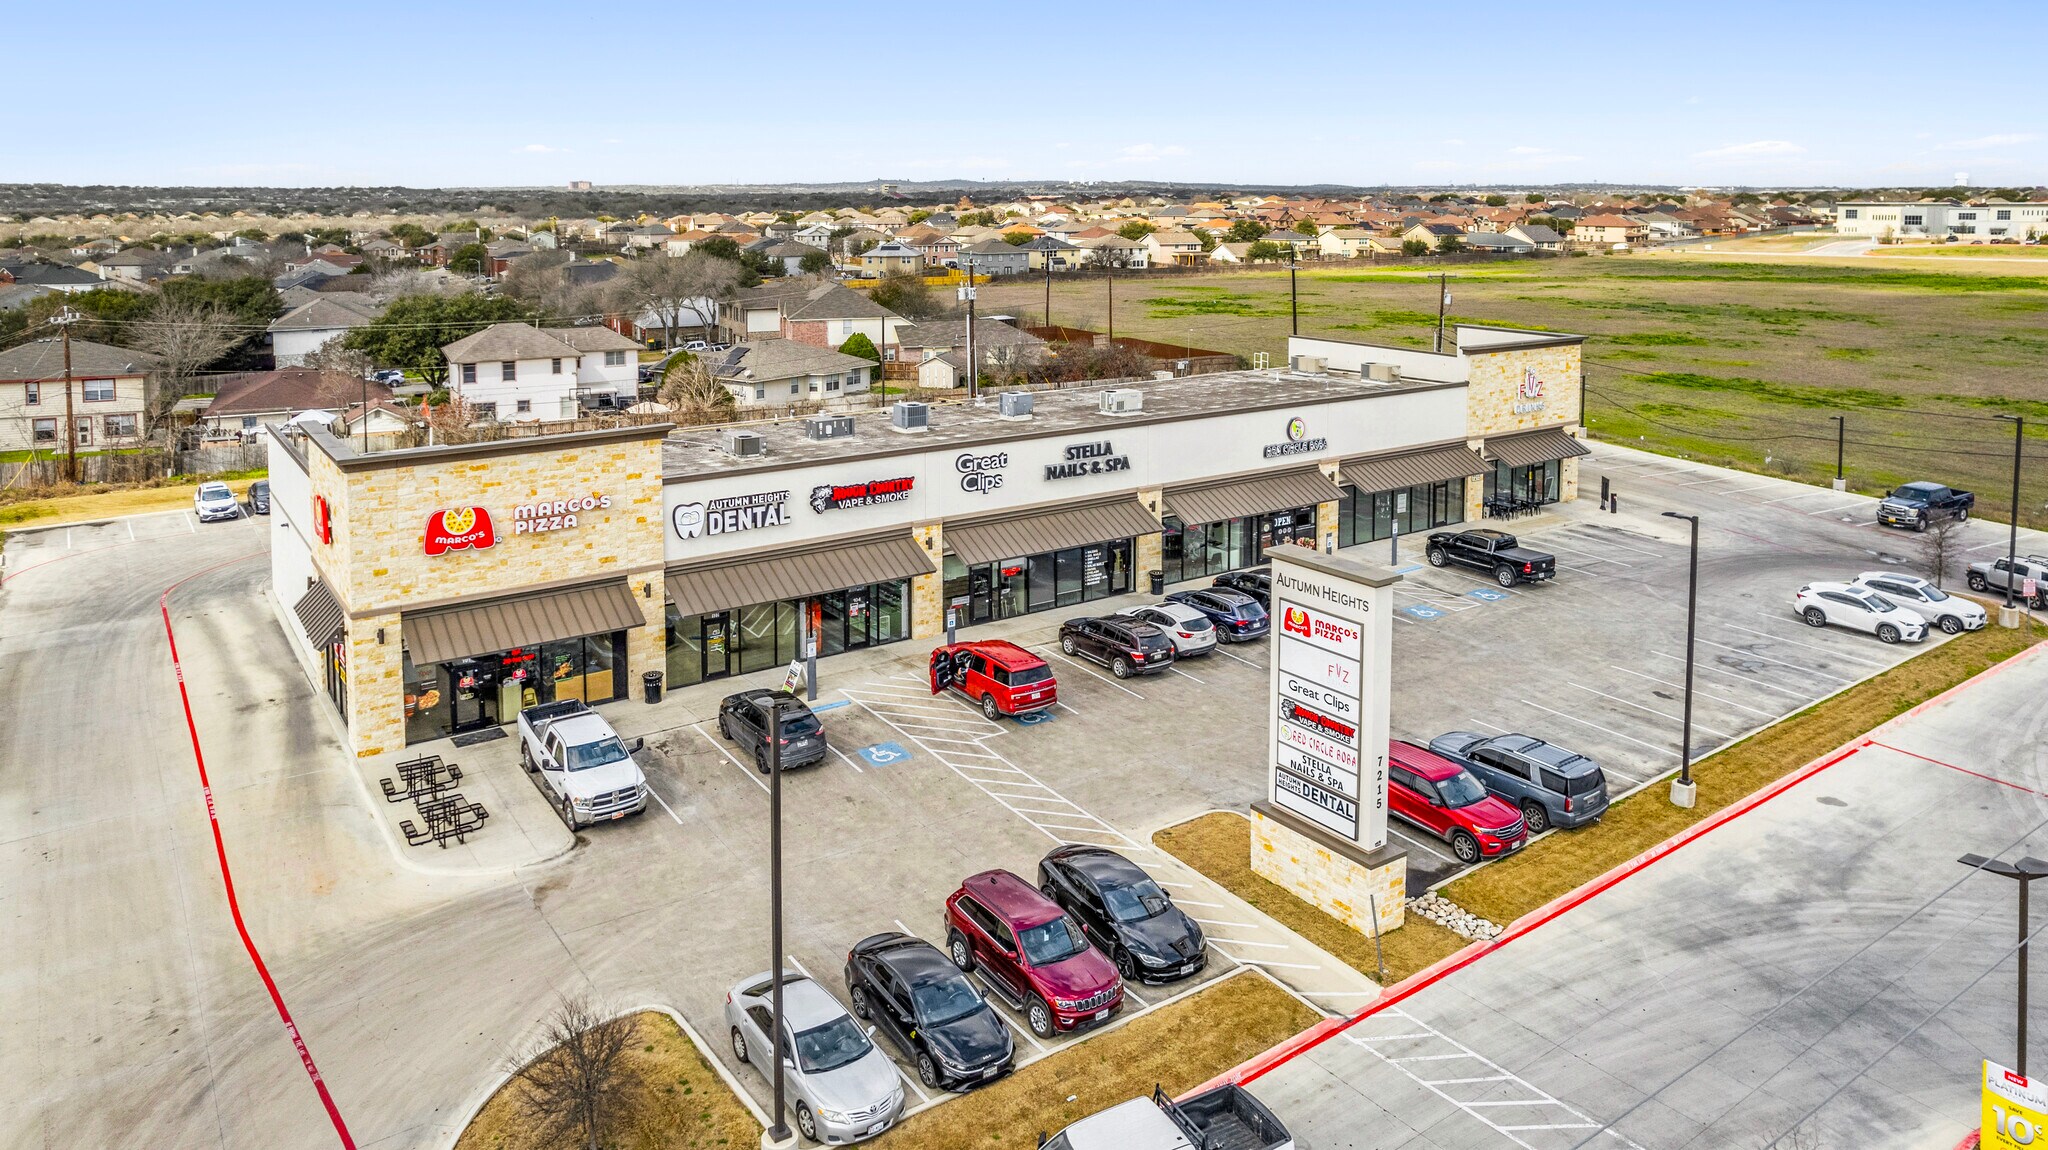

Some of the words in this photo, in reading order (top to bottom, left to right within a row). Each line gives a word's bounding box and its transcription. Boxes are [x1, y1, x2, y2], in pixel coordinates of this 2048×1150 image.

[1065, 440, 1113, 460] STELLA
[956, 452, 1008, 473] Great
[1045, 462, 1088, 480] NAILS
[1090, 461, 1101, 474] &
[1104, 456, 1130, 472] SPA
[961, 472, 1003, 494] Clips
[513, 493, 612, 520] MARCO'S
[710, 495, 750, 510] AUTUMN
[751, 490, 791, 505] HEIGHTS
[838, 498, 864, 509] VAPE
[865, 496, 873, 505] &
[875, 492, 909, 504] SMOKE
[515, 514, 578, 535] PIZZA
[709, 502, 791, 535] DENTAL
[435, 530, 485, 544] MARCO'S
[1276, 572, 1320, 597] AUTUMN
[1322, 585, 1370, 612] HEIGHTS
[1315, 619, 1358, 640] MARCO'S
[1315, 627, 1342, 643] PIZZA
[1288, 679, 1320, 701] Great
[1323, 693, 1350, 712] Clips
[1298, 716, 1317, 731] VAPE
[1317, 724, 1323, 733] &
[1324, 726, 1351, 744] SMOKE
[1292, 729, 1306, 745] RED
[1309, 737, 1333, 758] CIRCLE
[1336, 749, 1356, 767] BOBA
[1290, 760, 1315, 778] NAILS
[1318, 773, 1324, 782] &
[1327, 776, 1344, 791] SPA
[1302, 755, 1332, 775] STELLA
[1278, 772, 1301, 787] AUTUMN
[1278, 779, 1301, 793] HEIGHTS
[1302, 783, 1354, 818] DENTAL
[2007, 1075, 2024, 1085] NEW
[1988, 1076, 2047, 1108] PLATINUM
[2008, 1106, 2023, 1116] SAVE
